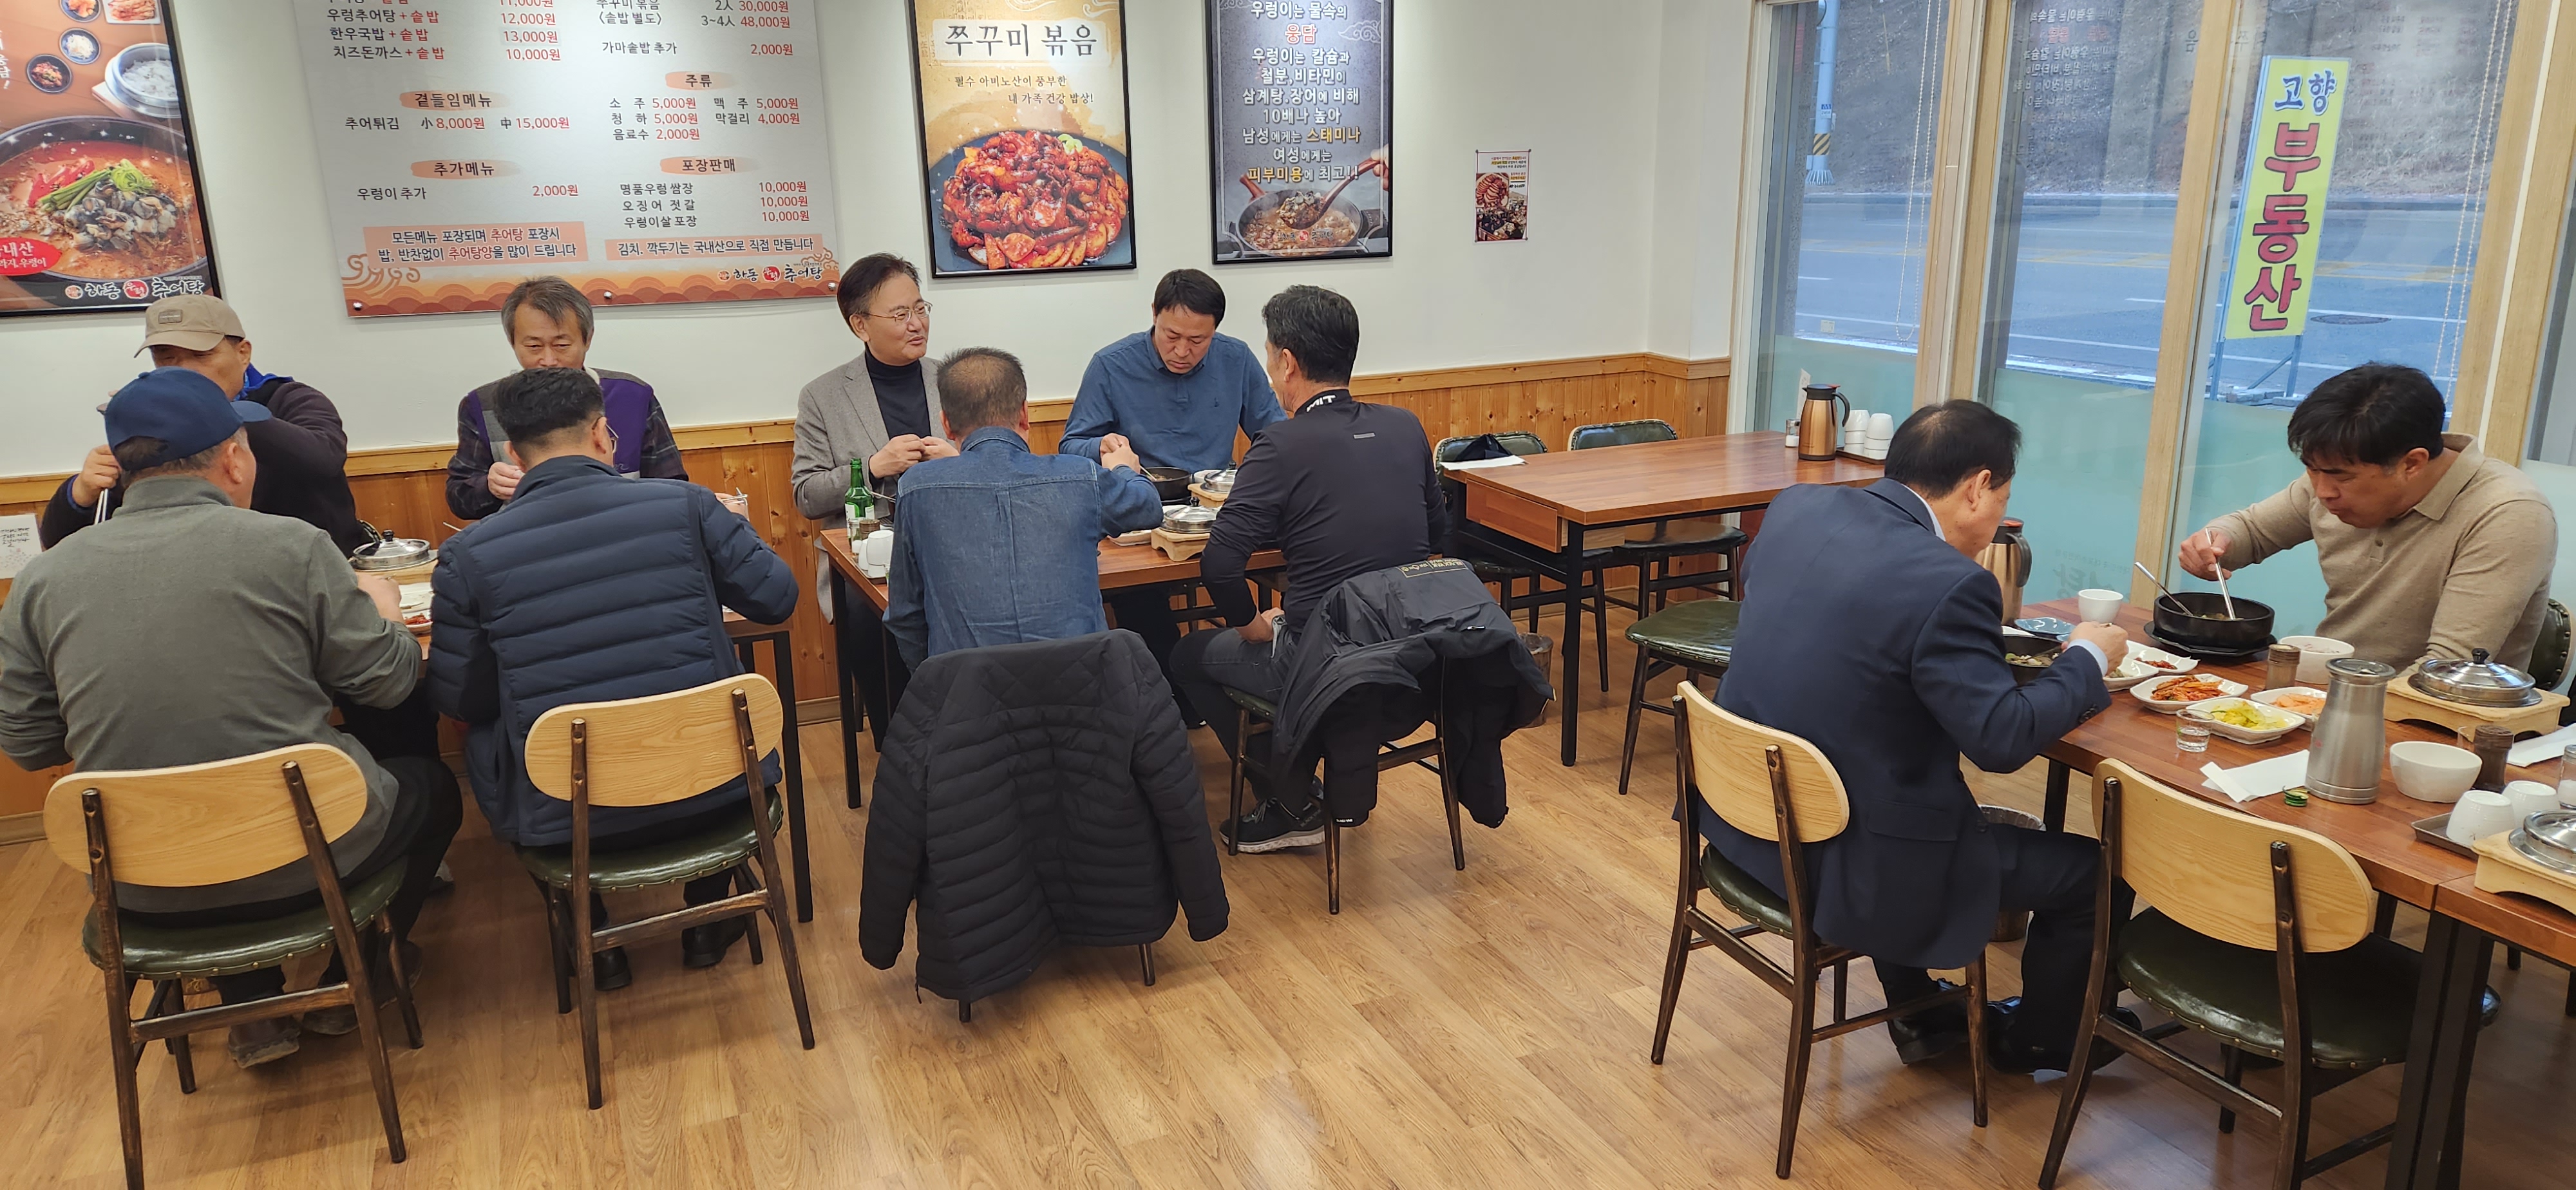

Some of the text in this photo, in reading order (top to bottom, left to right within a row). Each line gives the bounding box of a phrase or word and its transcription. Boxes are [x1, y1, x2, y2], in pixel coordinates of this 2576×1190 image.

[739, 1, 789, 13] 30,000원
[1251, 1, 1347, 19] 우렁이는 물속의
[327, 9, 395, 23] 우렁추어탕
[500, 13, 556, 26] 12,000원
[740, 16, 790, 28] 48,000원
[330, 28, 384, 41] 한우국밥
[503, 31, 558, 44] 13,000원
[945, 23, 1029, 57] 쭈꾸미
[1041, 24, 1097, 57] 볶음
[1285, 24, 1317, 44] 웅담
[334, 46, 402, 59] 치즈돈까스
[506, 48, 561, 61] 10,000원
[601, 41, 677, 55] 가마솥밥 추가
[750, 44, 793, 56] 2,000원
[1252, 47, 1350, 65] 우렁이는 칼슘과
[685, 73, 712, 88] 주류
[954, 75, 1067, 88] 필수 아미노산이 풍부한
[1009, 92, 1094, 104] 내 가족 건강 밥상!
[1333, 87, 1360, 104] 비해
[2274, 69, 2337, 114] 고향
[415, 93, 492, 108] 곁들임메뉴
[652, 97, 697, 109] 5,000원
[757, 97, 799, 109] 5,000원
[654, 113, 699, 125] 5,000원
[715, 113, 750, 125] 막걸리
[758, 113, 800, 125] 4,000원
[1263, 107, 1341, 124] 10배나 높아
[345, 117, 399, 130] 추어튀김
[436, 117, 485, 130] 8,000원
[515, 117, 570, 129] 15,000원
[613, 128, 700, 140] 음료수 2,000원
[1242, 126, 1361, 144] 남성에게는 스태미나
[1273, 147, 1332, 164] 여성에게는
[434, 162, 494, 176] 추가메뉴
[682, 158, 735, 173] 포장판매
[1247, 164, 1359, 183] 피부미용에 최고!!
[357, 185, 578, 201] 우렁이 추가 2,000원
[620, 181, 807, 196] 명품우렁 쌈장 10,000원
[623, 196, 808, 212] 오징어 젓갈 10,000원
[624, 211, 810, 229] 우렁이살 포장 10,000원
[2244, 122, 2321, 332] 부동산
[392, 227, 560, 244] 모든메뉴 포장되며 추어탕 포장시
[378, 243, 576, 262] 밥, 반찬없이 추어탕양을 많이 드립니다
[647, 241, 690, 255] 깍두기는
[694, 240, 746, 253] 국내산으로
[749, 239, 769, 251] 직접
[773, 238, 813, 250] 만듭니다
[734, 268, 758, 281] 하동
[784, 264, 822, 282] 추어탕
